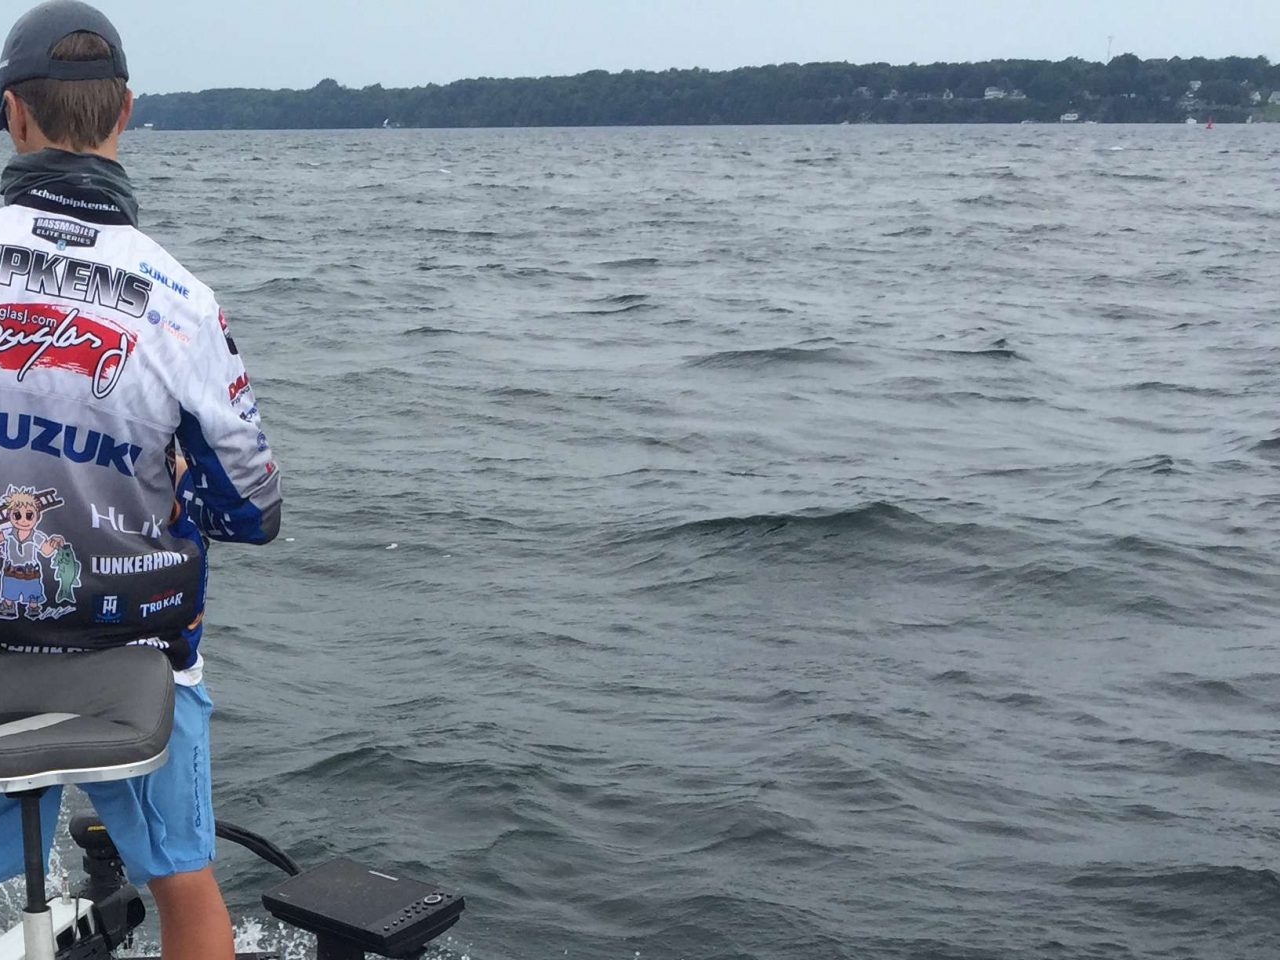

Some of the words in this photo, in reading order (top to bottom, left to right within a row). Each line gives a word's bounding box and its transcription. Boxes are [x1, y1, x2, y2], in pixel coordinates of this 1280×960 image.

[36, 228, 59, 238] ELITE
[61, 233, 91, 245] SERIES
[139, 261, 190, 300] SUNLINE
[140, 592, 184, 618] TROKAR
